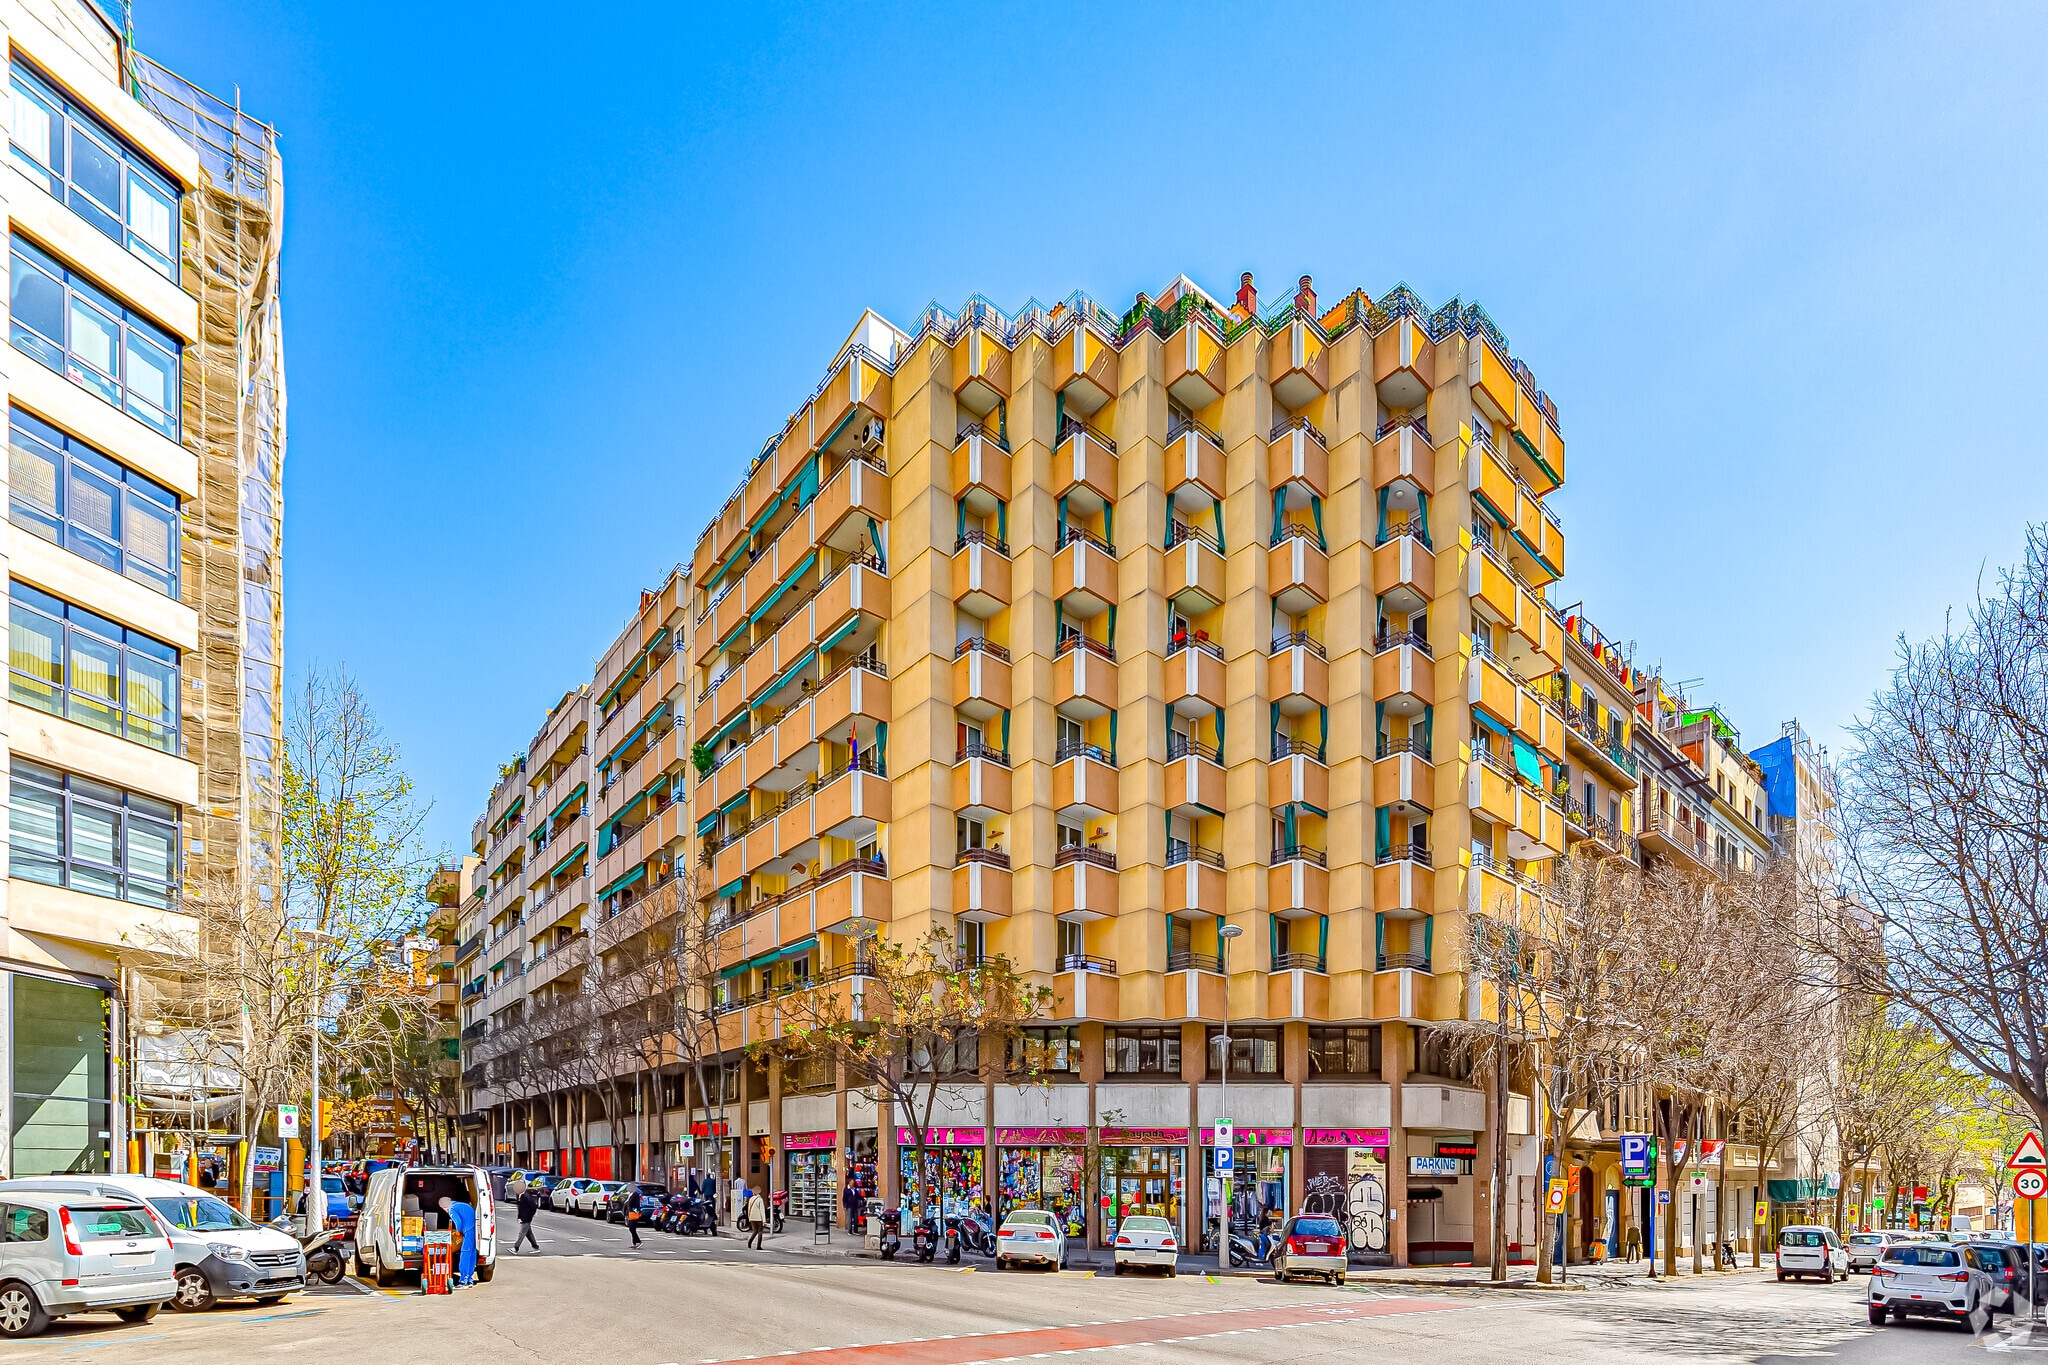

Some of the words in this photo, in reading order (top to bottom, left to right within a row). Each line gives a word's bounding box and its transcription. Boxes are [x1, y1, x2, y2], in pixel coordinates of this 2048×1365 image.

[1625, 1139, 1644, 1160] P
[1217, 1150, 1230, 1167] P
[1416, 1157, 1456, 1170] PARKING
[2020, 1178, 2040, 1189] 30
